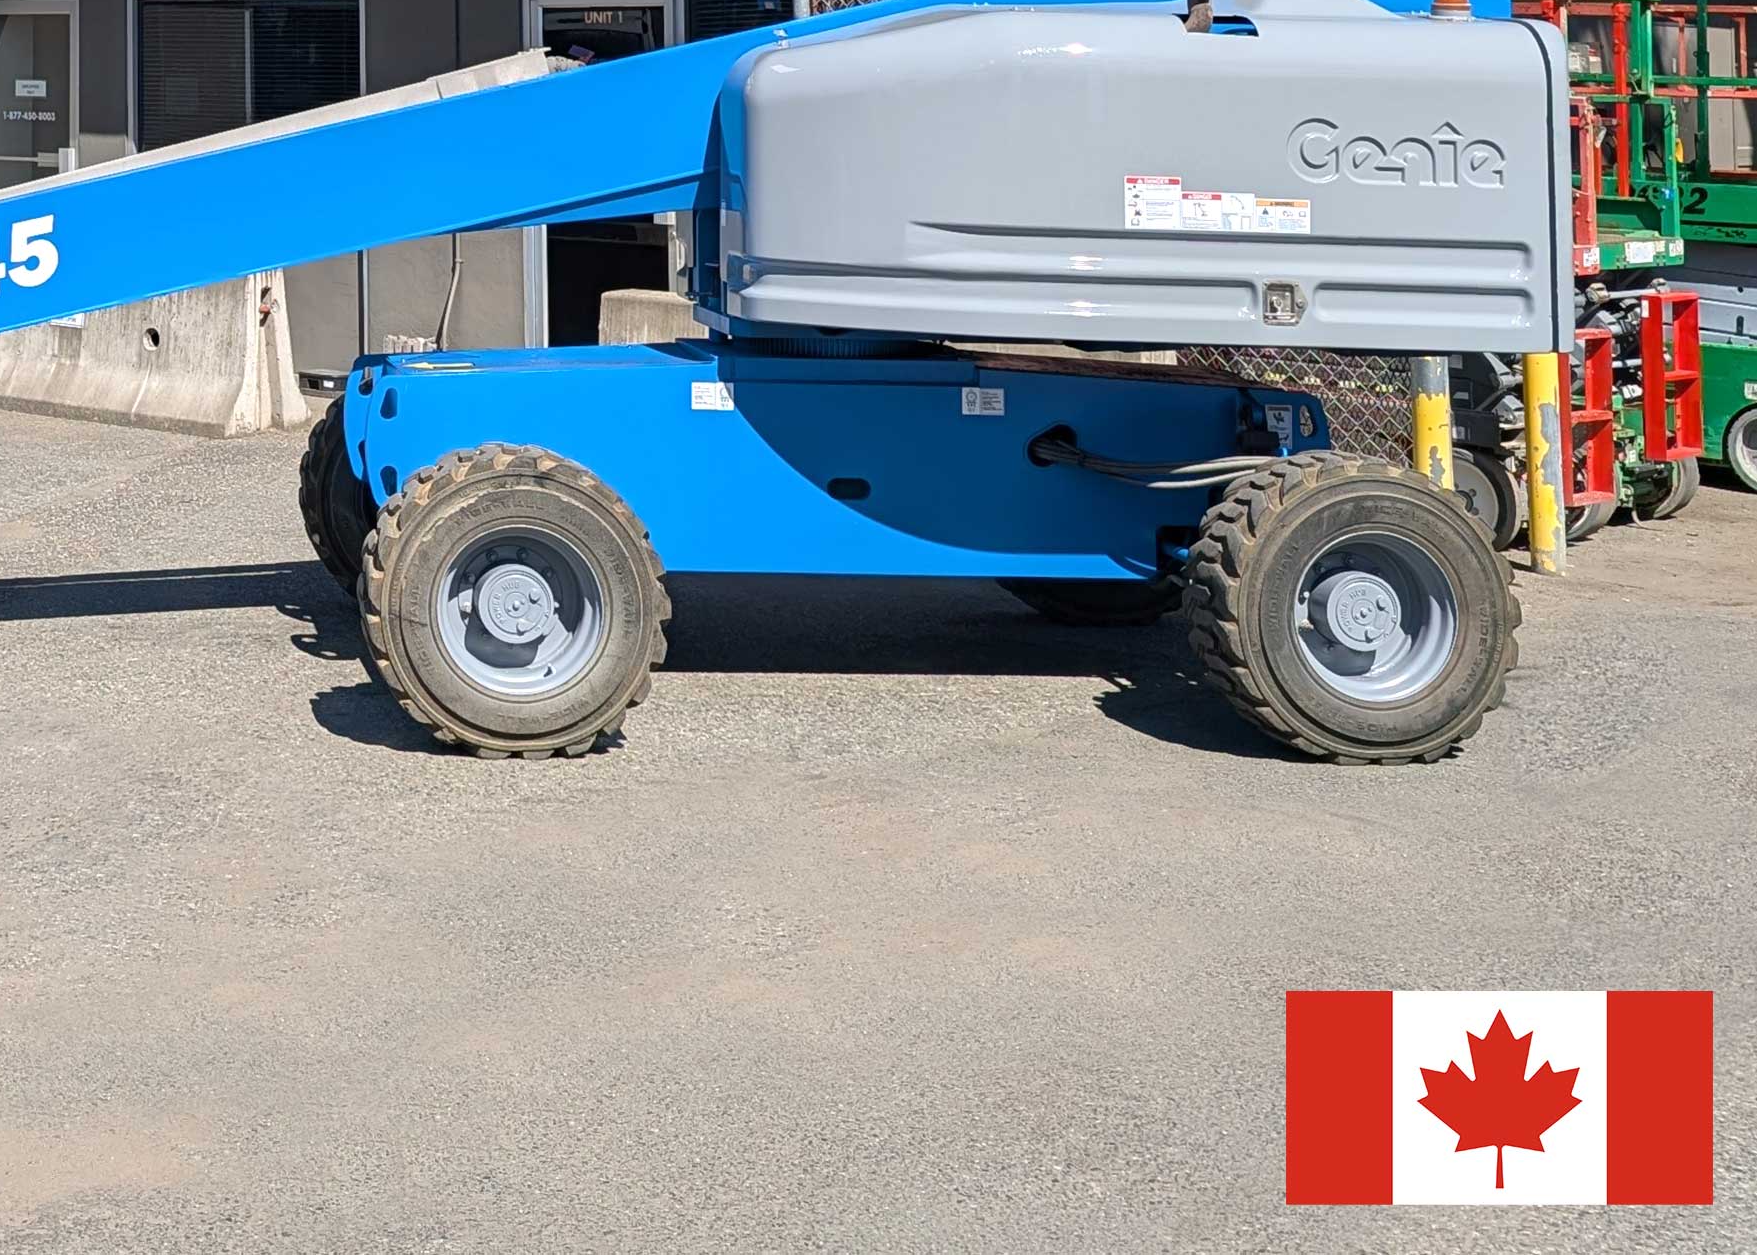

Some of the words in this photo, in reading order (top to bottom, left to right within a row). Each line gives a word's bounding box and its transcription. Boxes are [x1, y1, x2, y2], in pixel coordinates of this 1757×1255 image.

[584, 10, 613, 24] UNIT
[618, 10, 623, 24] 1
[1286, 116, 1507, 189] Genie
